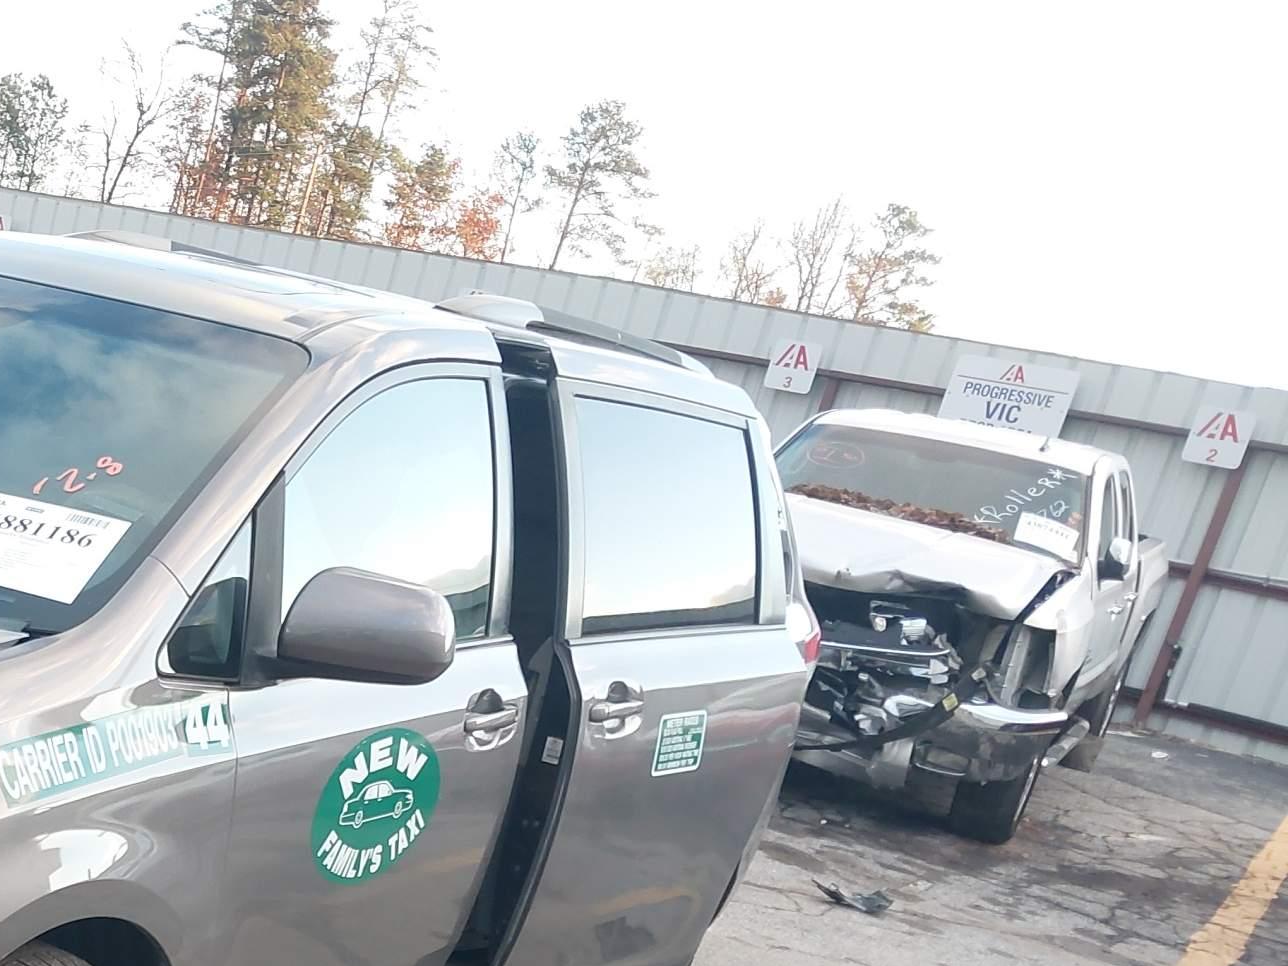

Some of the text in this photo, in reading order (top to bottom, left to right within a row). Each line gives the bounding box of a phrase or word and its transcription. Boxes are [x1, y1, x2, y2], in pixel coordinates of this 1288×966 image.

[783, 376, 793, 389] 3
[963, 381, 1054, 409] PROGRESSIVE
[984, 400, 1021, 424] VIC
[1206, 448, 1218, 463] 2
[184, 703, 230, 750] 44
[82, 725, 106, 774] ID
[338, 735, 429, 800] NEW
[316, 808, 425, 880] FAMILY'S TAXI
